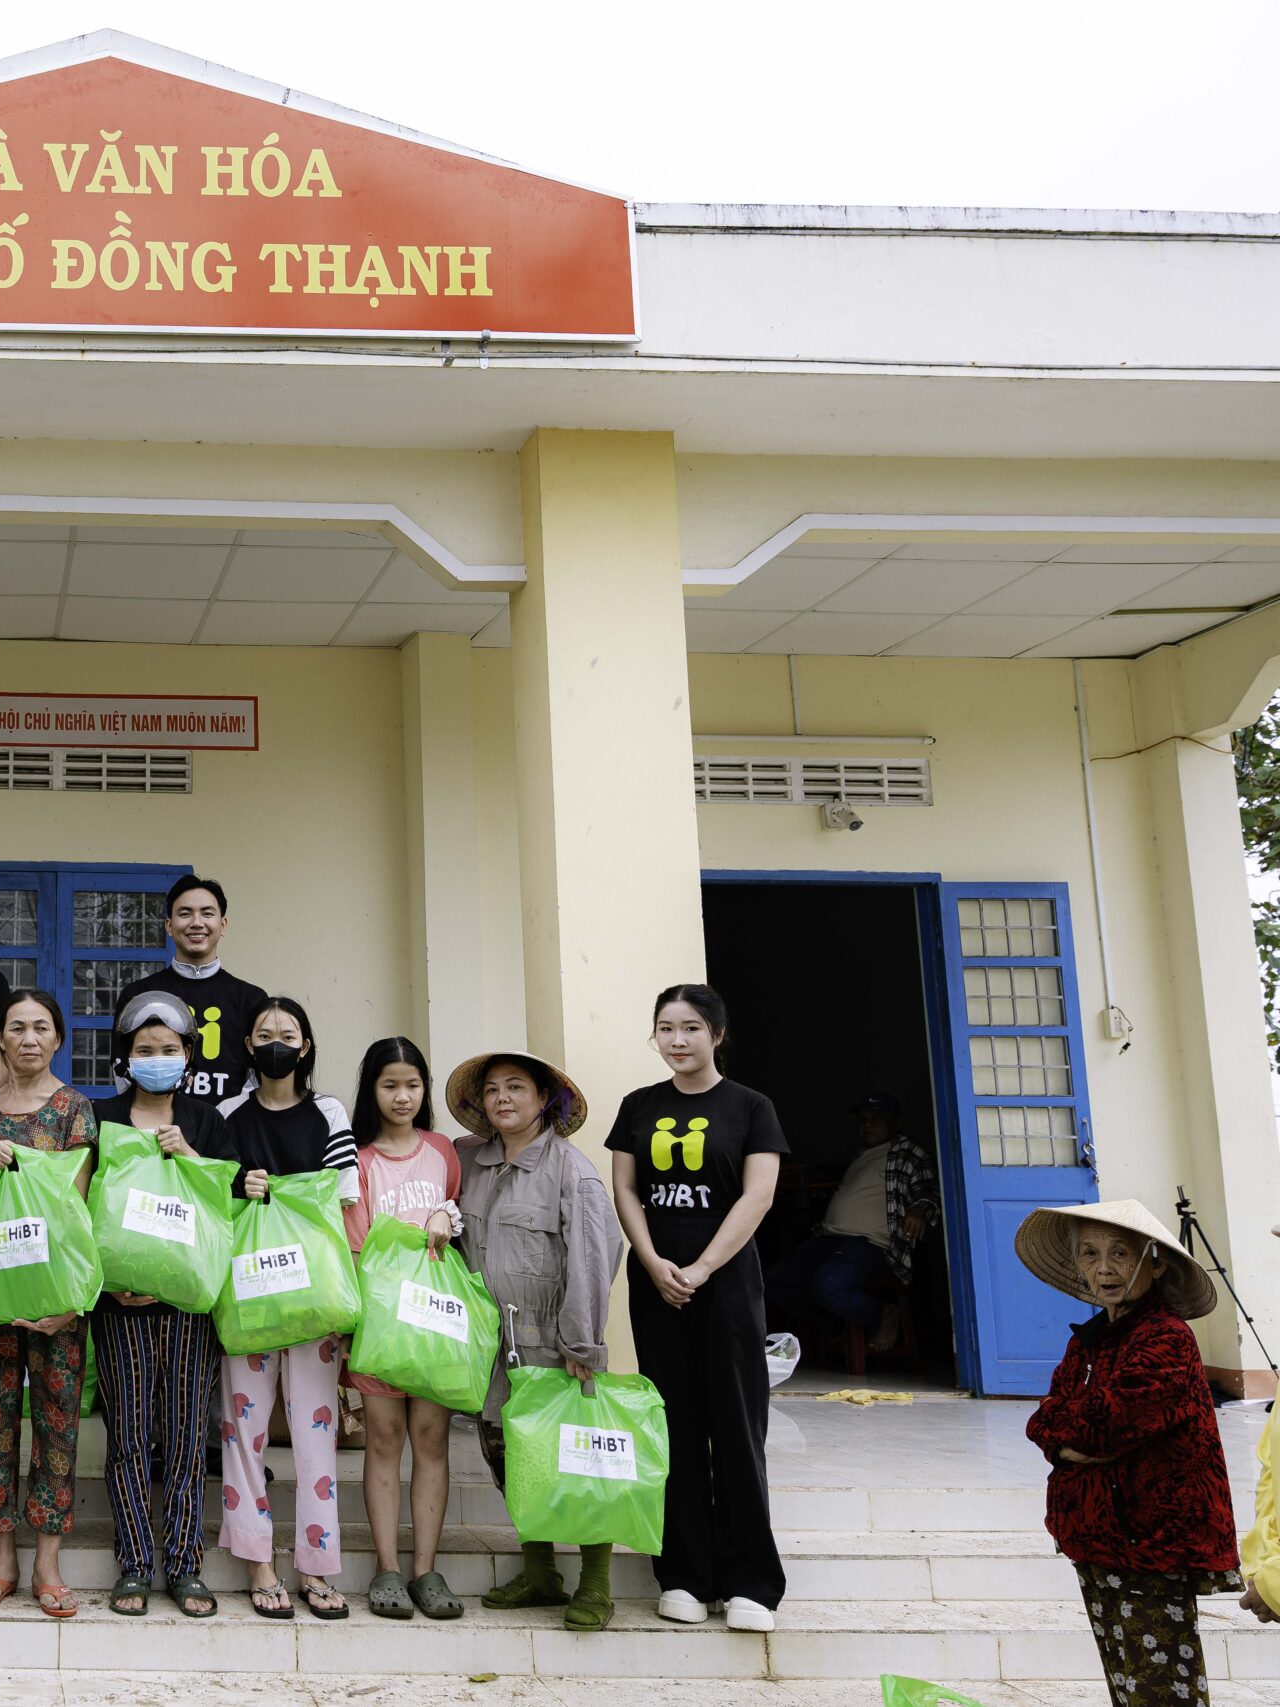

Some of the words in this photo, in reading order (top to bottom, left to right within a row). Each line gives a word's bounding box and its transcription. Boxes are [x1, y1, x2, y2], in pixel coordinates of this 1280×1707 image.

[43, 129, 178, 195] VĂN
[201, 132, 342, 198] HÓA
[51, 210, 238, 293] ĐỒNG
[258, 244, 494, 309] THẠNH
[24, 707, 51, 731] CHỦ
[55, 710, 96, 732] NGHĨA
[100, 710, 127, 735] VIỆT
[131, 714, 162, 733] NAM
[166, 712, 206, 733] MUÔN
[210, 712, 246, 733] NĂM!
[651, 1184, 711, 1208] HiBT
[9, 1223, 41, 1241] HiBT
[259, 1252, 297, 1270] HiBT
[429, 1295, 463, 1317] HiBT
[591, 1435, 627, 1452] HiBT
